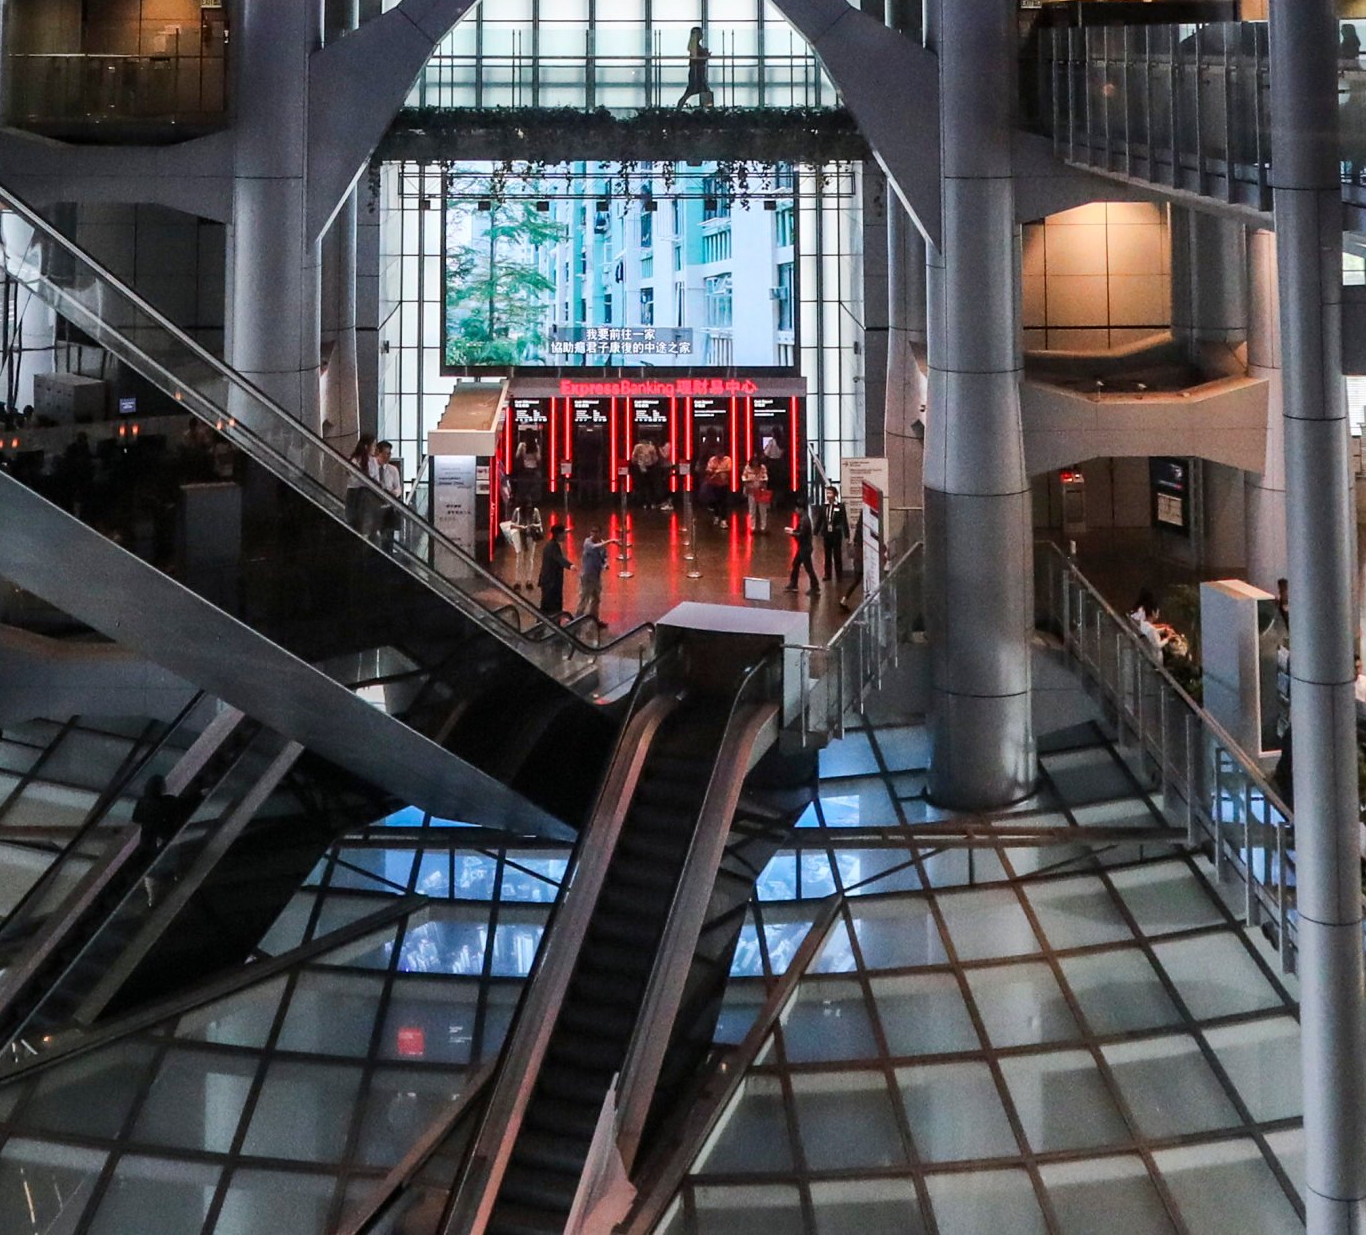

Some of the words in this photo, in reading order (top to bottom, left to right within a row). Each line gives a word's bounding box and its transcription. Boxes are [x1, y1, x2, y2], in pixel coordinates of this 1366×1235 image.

[586, 328, 655, 340] 我要前往一家
[675, 379, 759, 395] 理財易中心
